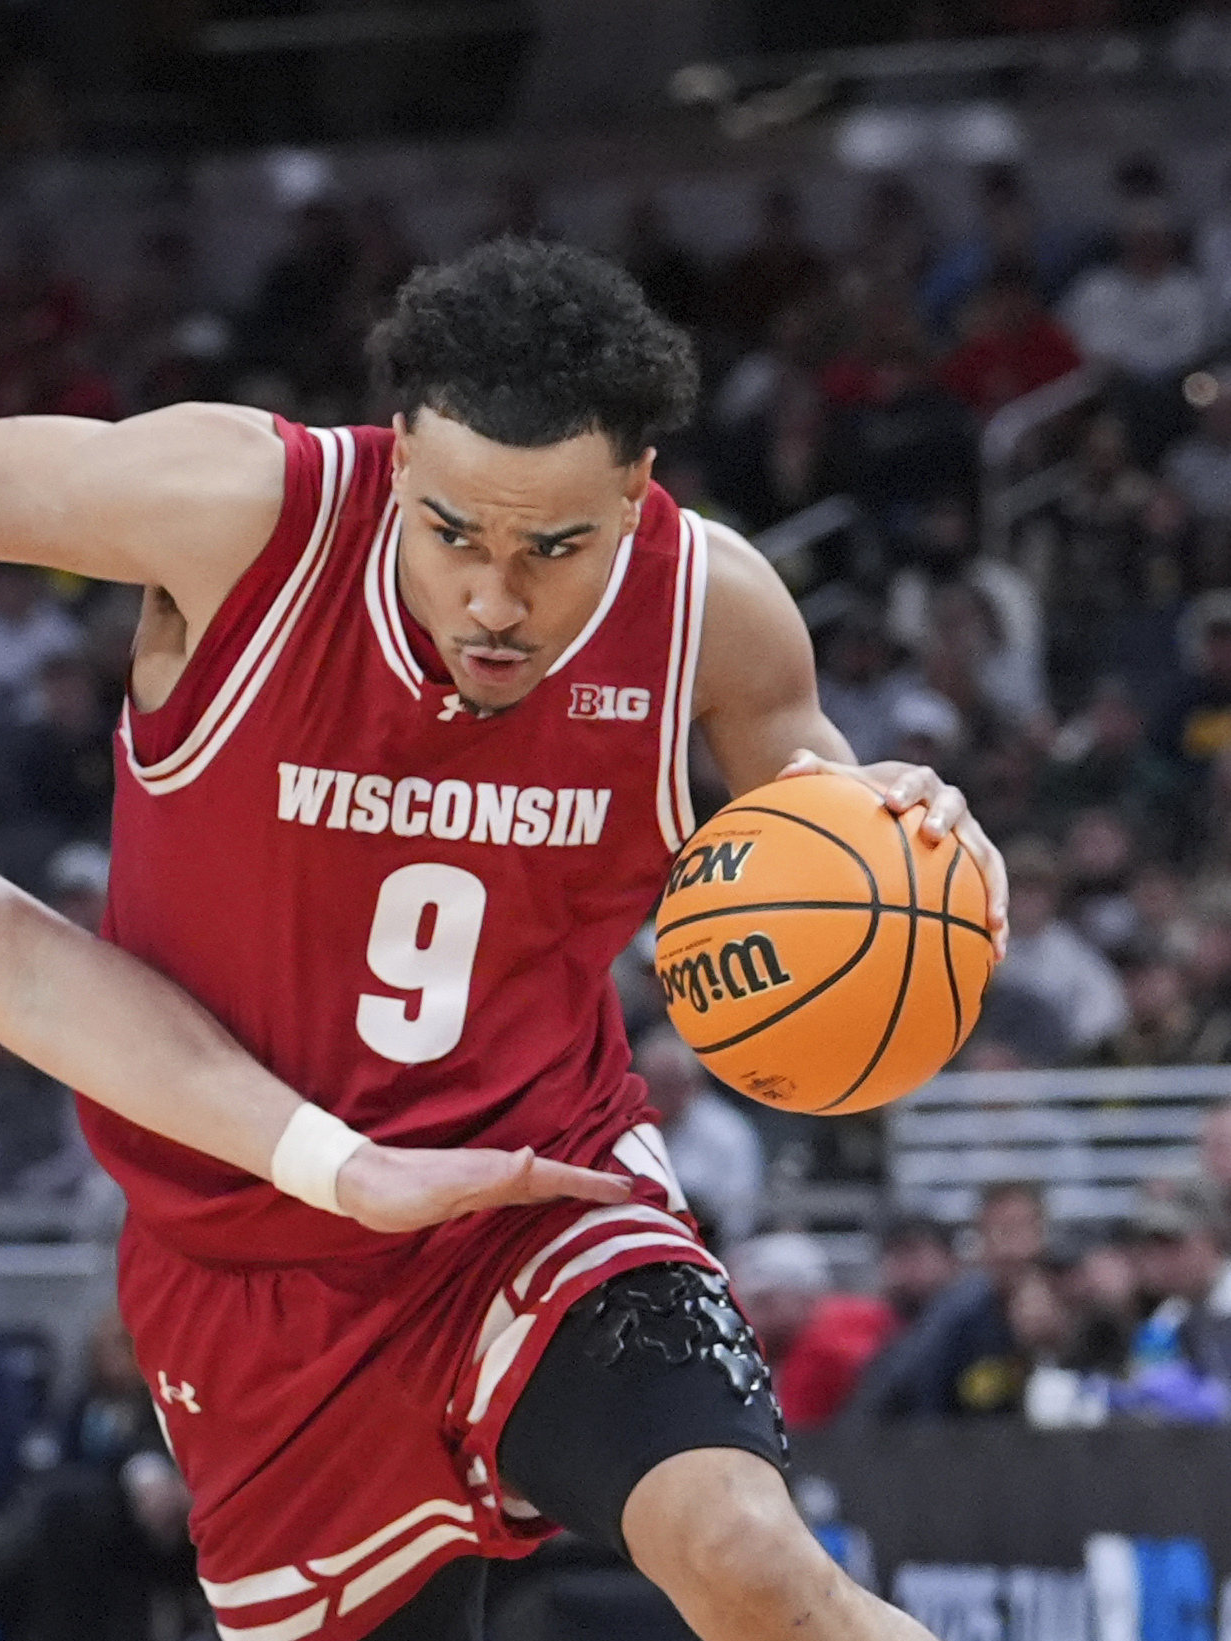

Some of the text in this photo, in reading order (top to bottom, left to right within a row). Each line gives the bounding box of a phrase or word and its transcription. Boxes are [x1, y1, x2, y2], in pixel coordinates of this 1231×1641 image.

[568, 683, 651, 721] BIG
[277, 761, 612, 846] WISCONSIN
[356, 862, 487, 1064] 9
